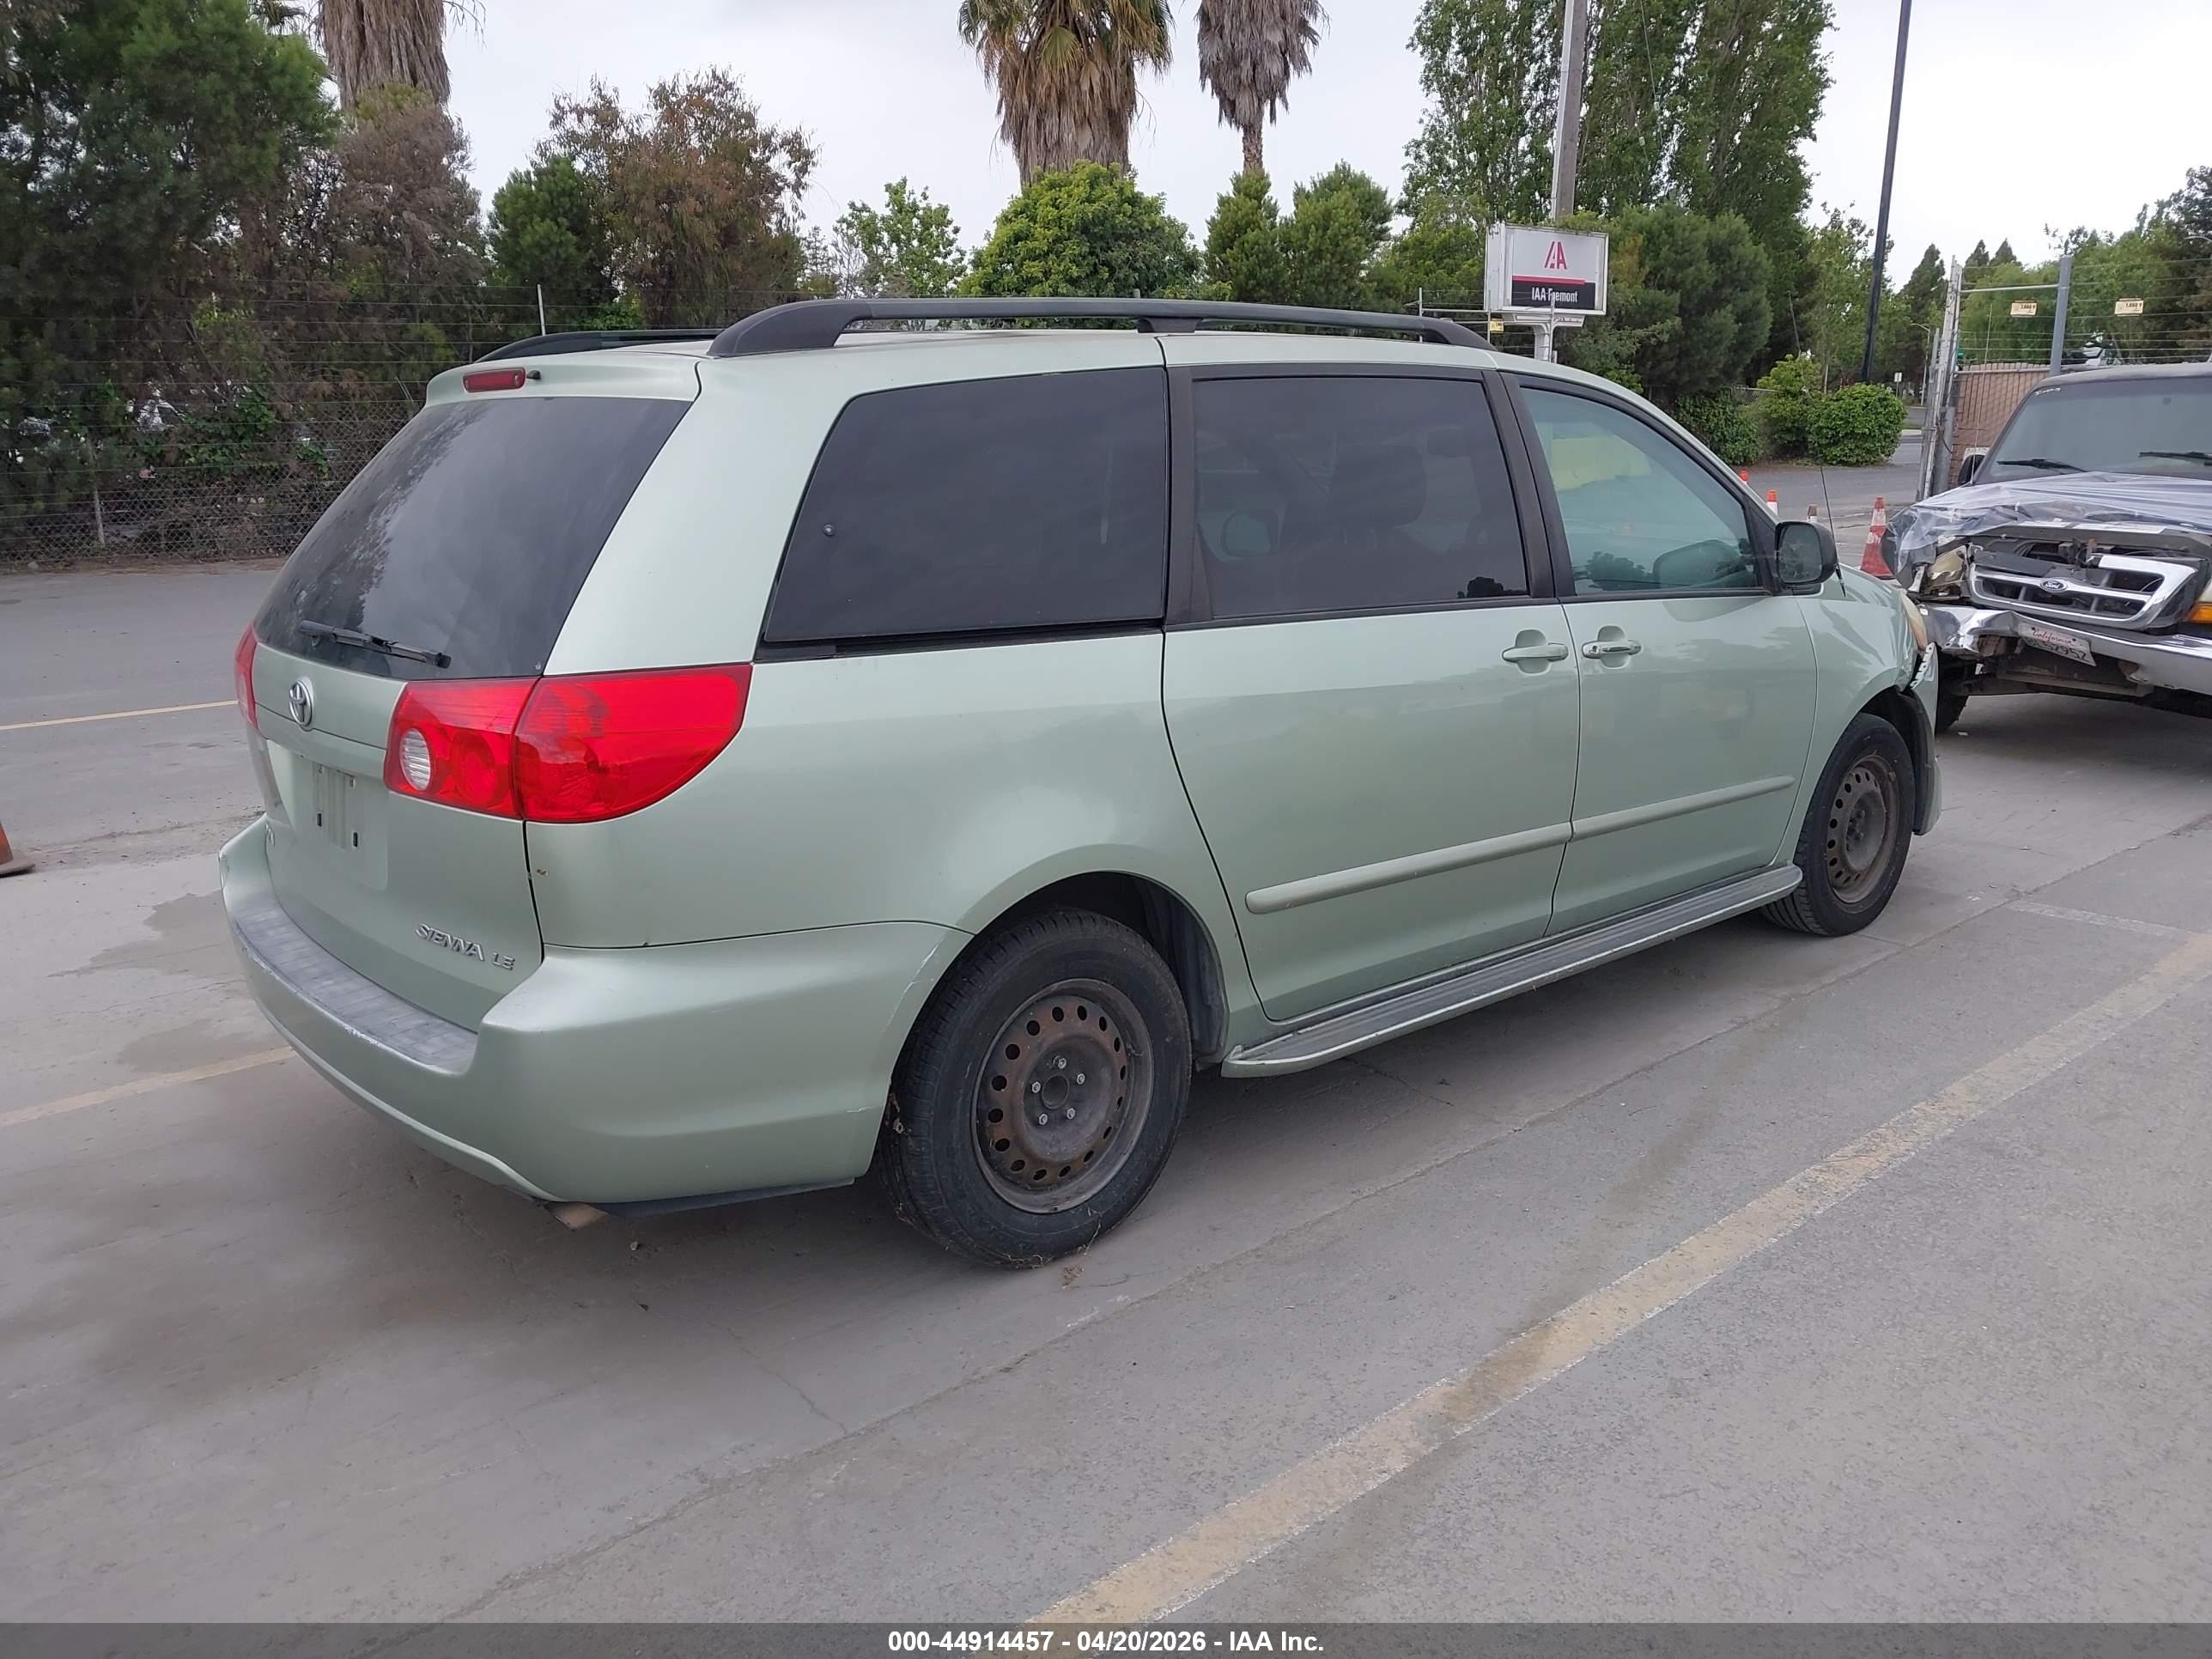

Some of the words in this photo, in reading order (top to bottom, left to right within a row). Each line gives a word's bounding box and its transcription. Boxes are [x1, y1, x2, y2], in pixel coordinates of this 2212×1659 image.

[1531, 287, 1547, 301] IAA
[416, 923, 484, 961] SIENNA
[492, 951, 515, 970] LE
